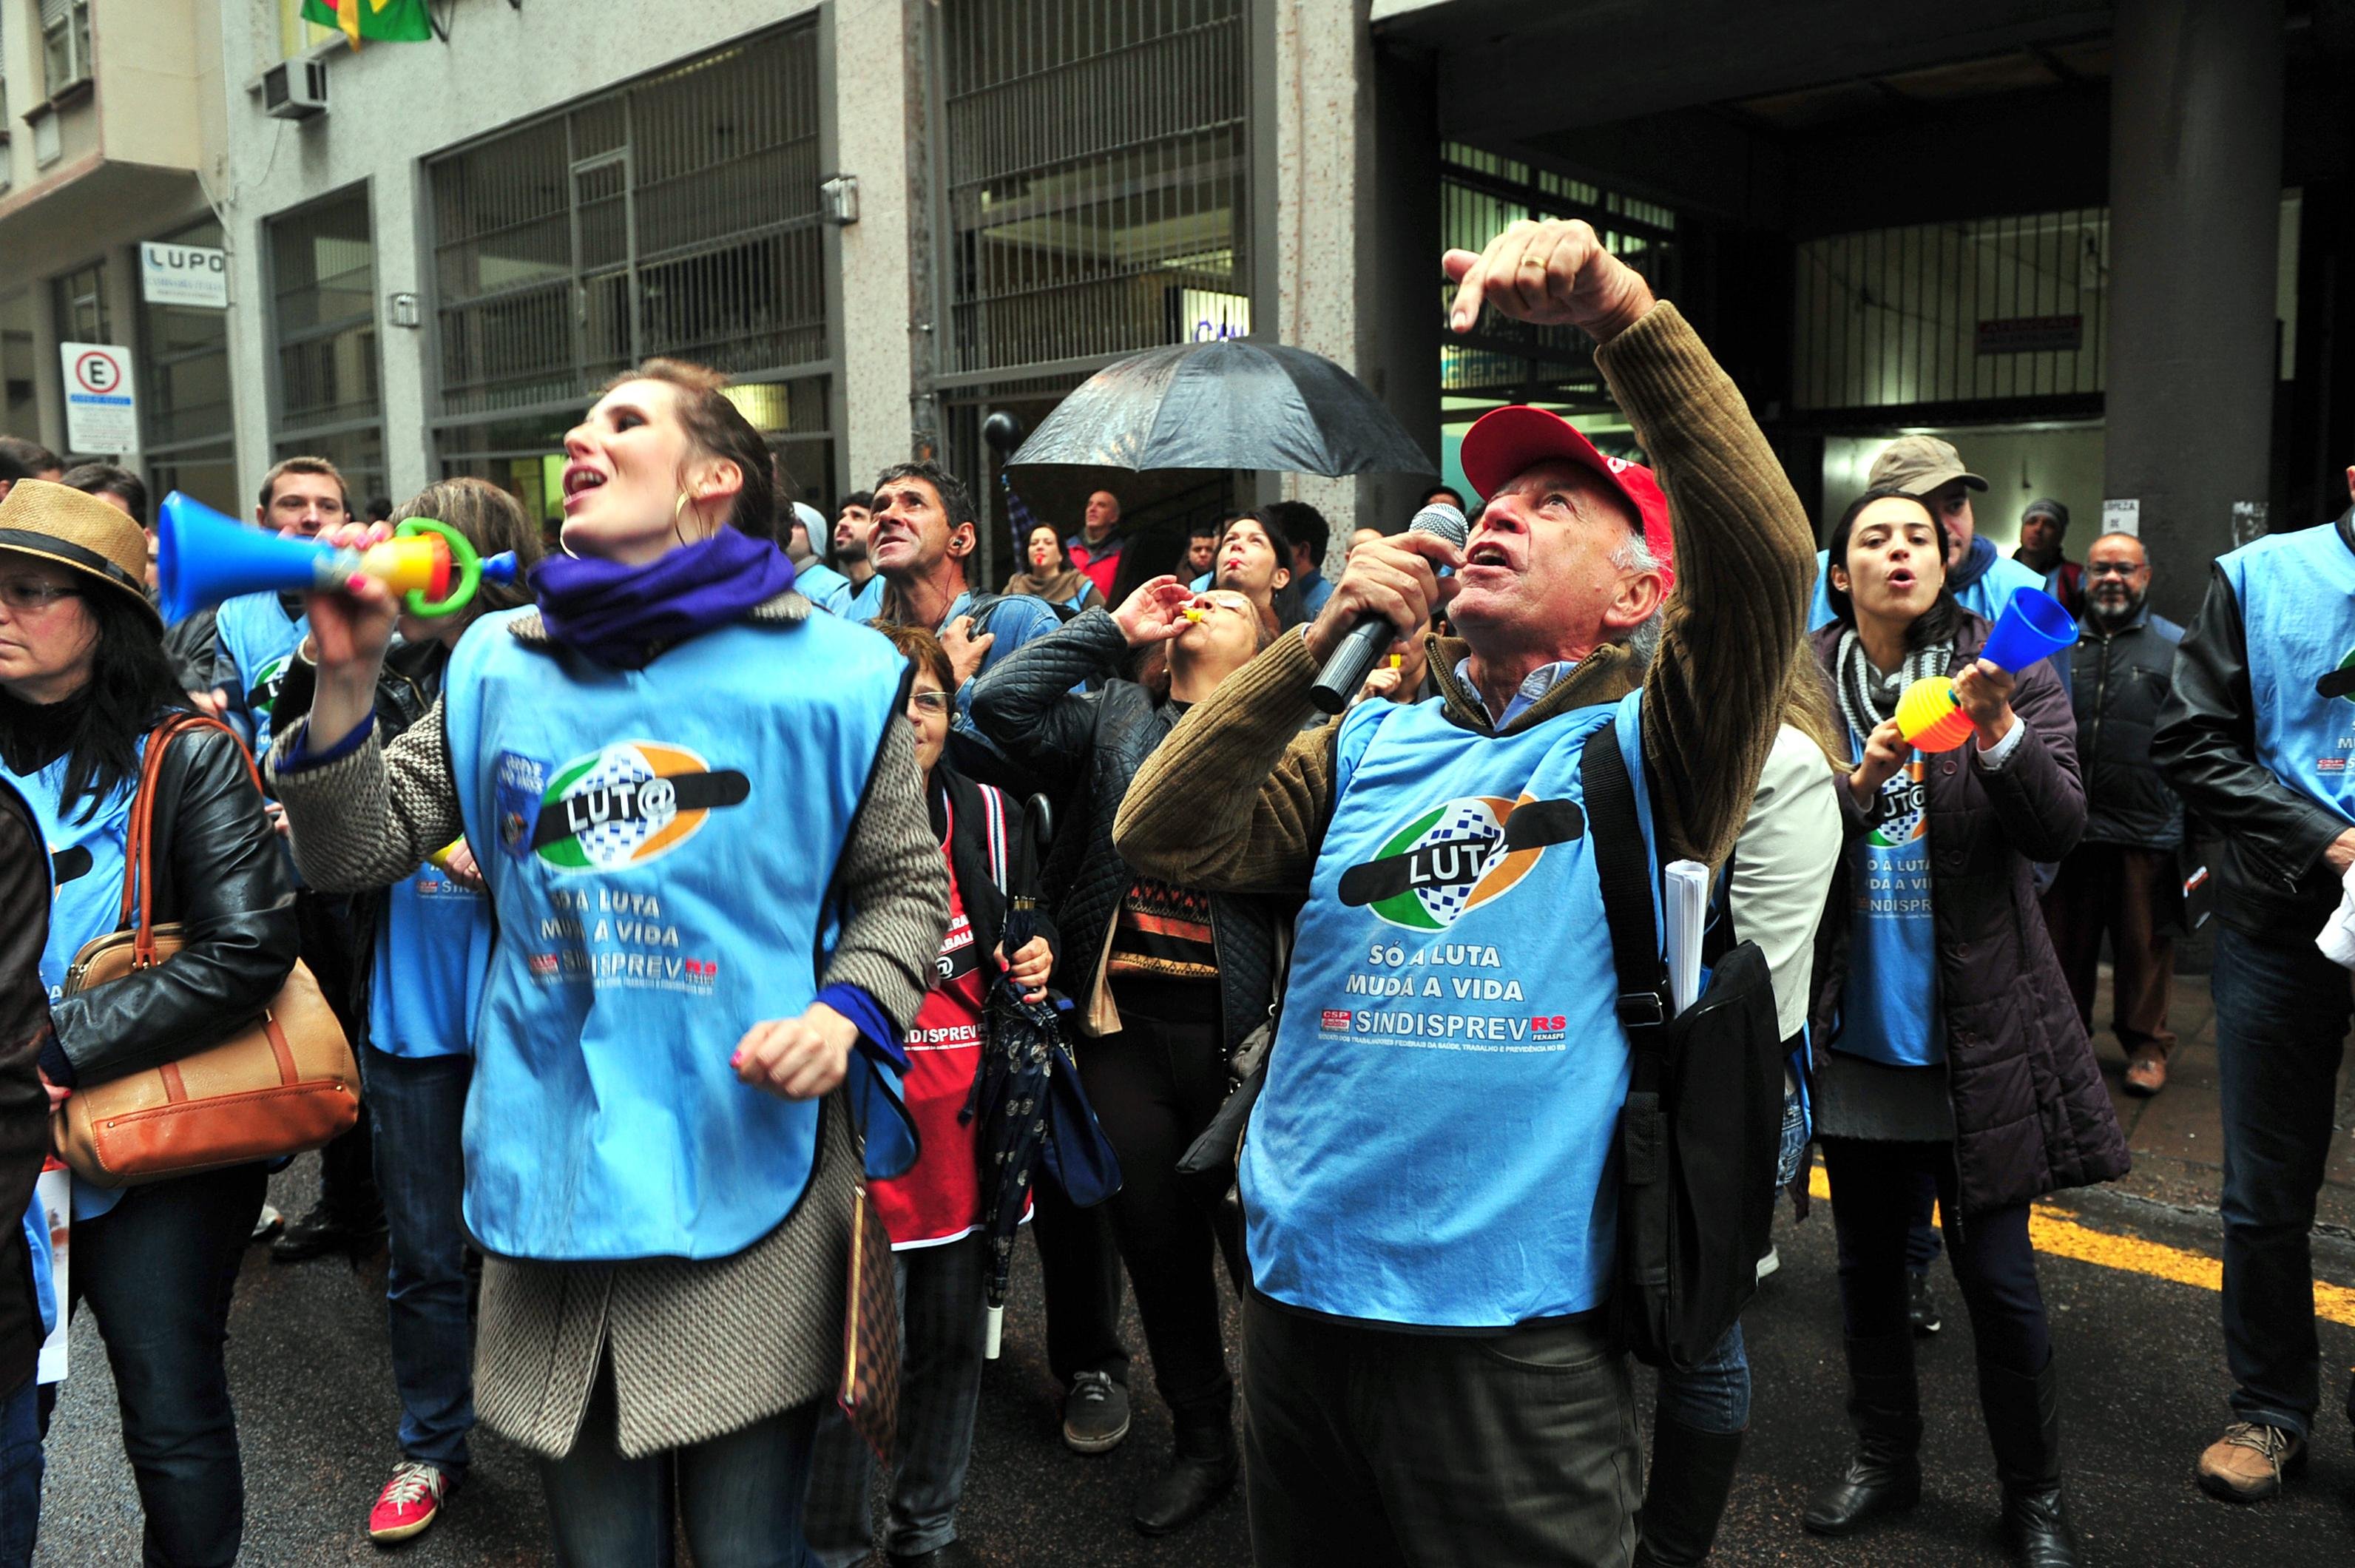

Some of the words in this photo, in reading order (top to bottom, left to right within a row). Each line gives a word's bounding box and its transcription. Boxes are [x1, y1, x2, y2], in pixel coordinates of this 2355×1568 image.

[146, 249, 224, 273] LUPO
[89, 359, 105, 385] E
[566, 778, 677, 834] LUT@
[1896, 879, 1906, 890] A
[575, 887, 590, 913] A
[598, 888, 661, 919] LUTA
[594, 918, 609, 943] A
[616, 919, 680, 949] VIDA
[1368, 941, 1405, 967] SÓ
[1408, 947, 1425, 967] A
[1430, 944, 1501, 968] LUTA
[1345, 973, 1416, 997] MUDA
[1422, 976, 1443, 998] A
[1450, 977, 1524, 1001] VIDA
[1323, 1010, 1348, 1018] CSP
[1355, 1010, 1529, 1041] SINDISPREV
[1531, 1015, 1567, 1032] RS
